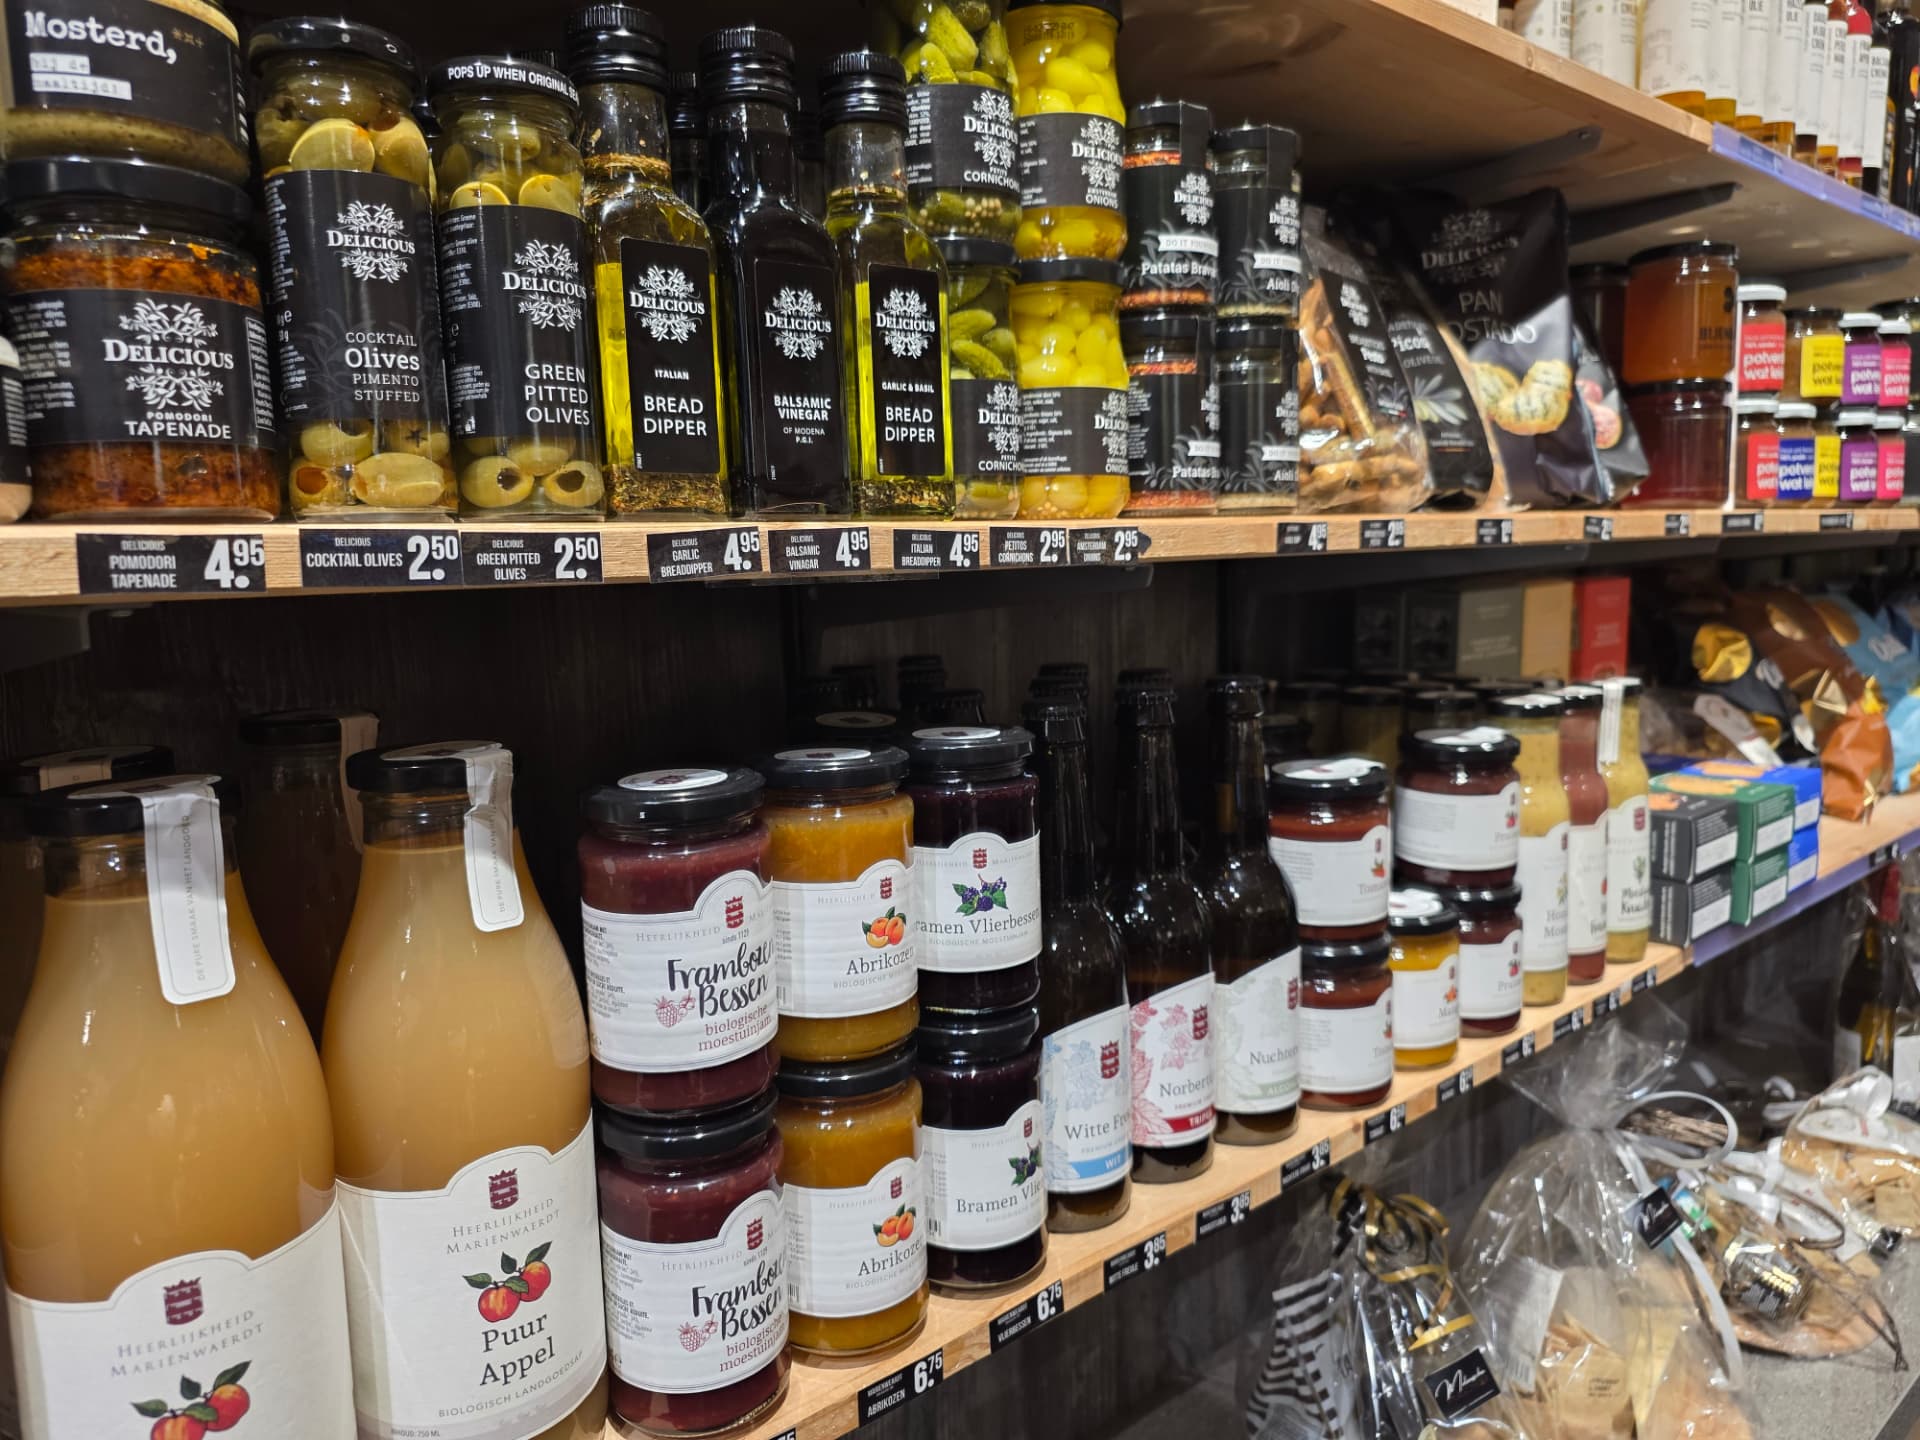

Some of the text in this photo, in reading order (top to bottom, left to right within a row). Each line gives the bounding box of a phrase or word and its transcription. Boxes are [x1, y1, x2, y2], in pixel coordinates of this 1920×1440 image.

[24, 10, 177, 65] Mosterd,
[447, 64, 569, 96] POPS UP WHEN ORIGINAL
[326, 229, 416, 255] DELICIOUS
[1141, 261, 1189, 275] Patatas
[502, 271, 587, 300] DELICIOUS
[630, 290, 706, 316] DELICIOUS
[764, 311, 832, 334] DELICIOUS
[875, 311, 936, 334] DELICIOUS
[345, 331, 418, 347] COCKTAIL
[102, 338, 235, 370] DELICIOUS
[344, 347, 420, 371] Olives
[352, 373, 420, 387] PIMENTO
[524, 363, 586, 384] GREEN
[654, 368, 690, 381] ITALIAN
[354, 389, 421, 403] STUFFED
[524, 385, 589, 405] PITTED
[881, 381, 907, 392] GARLIC
[914, 381, 935, 394] BASIL
[643, 395, 704, 415] BREAD
[773, 394, 832, 410] BALSAMIC
[147, 411, 213, 422] POMODORI
[526, 406, 590, 426] OLIVES
[777, 406, 830, 422] VINEGAR
[885, 405, 934, 423] BREAD
[124, 420, 232, 440] TAPENADE
[643, 417, 707, 437] DIPPER
[783, 427, 826, 436] OF MODENA
[885, 426, 936, 443] DIPPER
[120, 540, 166, 551] DELICIOUS
[335, 537, 372, 547] DELICIOUS
[492, 539, 525, 549] DELICIOUS
[671, 537, 698, 548] DELICIOUS
[785, 545, 821, 557] BALSAMIC
[911, 543, 933, 554] ITALIAN
[108, 555, 177, 570] POMODORI
[306, 552, 404, 568] COCKTAIL OLIVES
[476, 552, 541, 566] GREEN PITTED
[672, 550, 700, 562] GARLIC
[789, 558, 819, 571] VINAGAR
[901, 556, 941, 567] BREADDIPPER
[998, 552, 1033, 563] CORNICHONS
[494, 567, 527, 581] OLIVES
[660, 562, 713, 578] BREADDIPPER
[110, 574, 177, 588] TAPENADE
[969, 908, 1040, 933] Vlierbessen
[846, 946, 914, 976] Abrikozen
[699, 974, 768, 1019] Bessen
[705, 1005, 768, 1036] biologische
[698, 1015, 772, 1052] moestuinjam
[1064, 1122, 1110, 1140] Witte
[1105, 1154, 1121, 1169] WIT
[956, 1194, 1018, 1213] Bramen
[451, 1197, 555, 1239] HEERLIJKHEID
[721, 1285, 783, 1341] Bessen
[117, 1309, 255, 1358] HEERLIJKHEID
[482, 1313, 548, 1353] Puur
[726, 1313, 783, 1357] biologische
[479, 1336, 556, 1386] Appel
[438, 1394, 512, 1418] BIOLOGISCH
[867, 1388, 906, 1418] ABRIKOZEN
